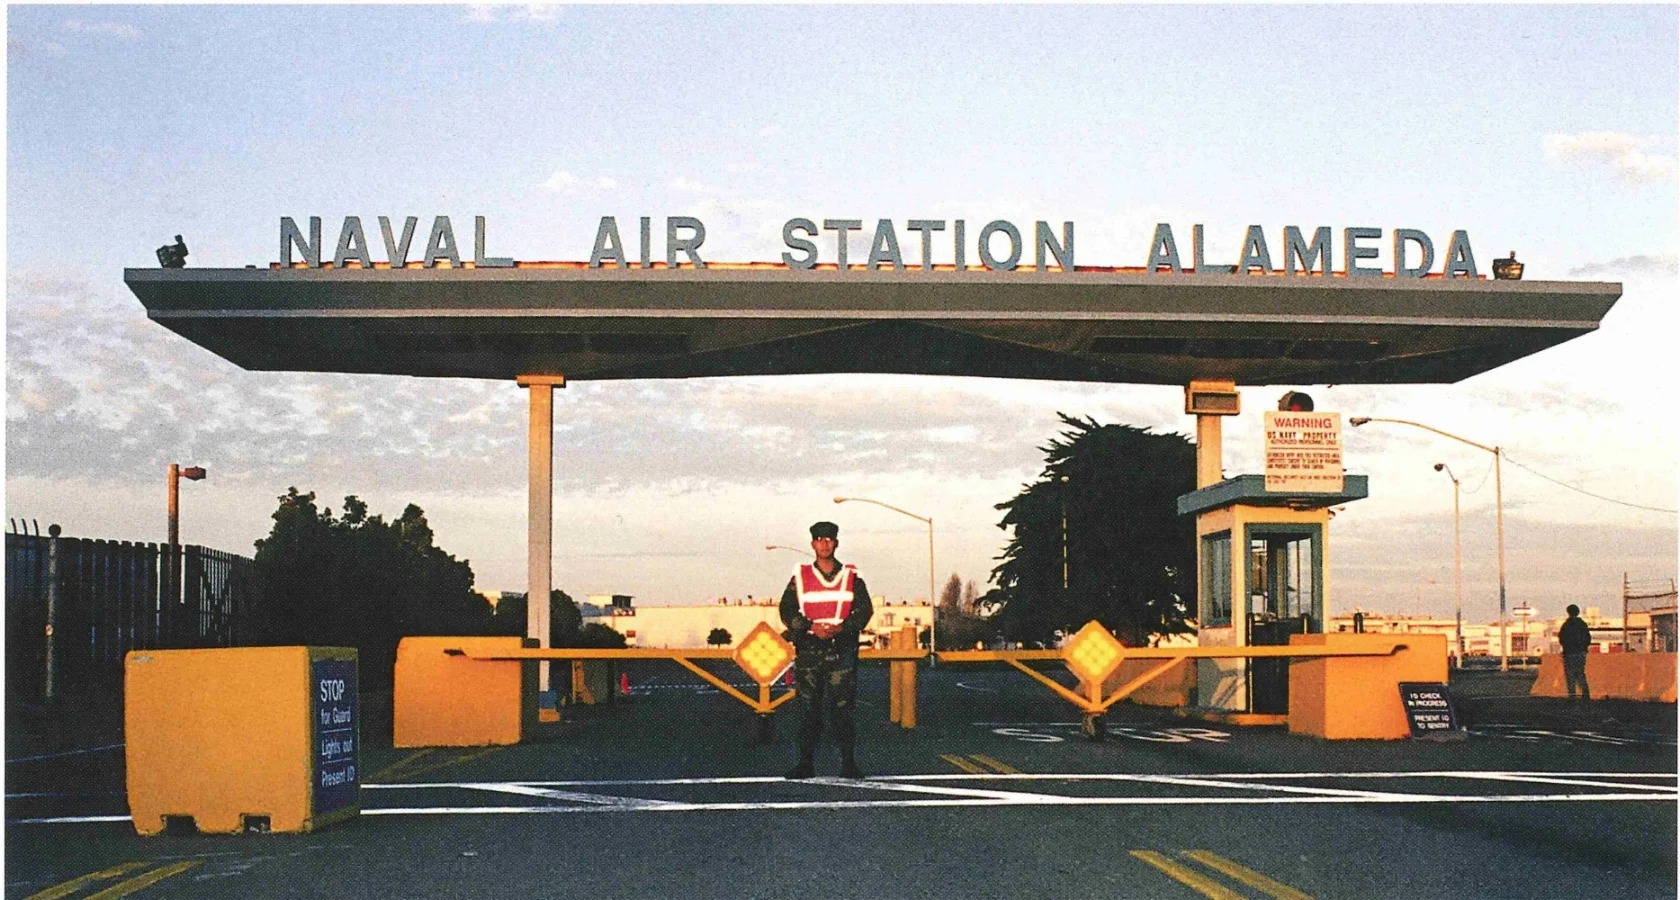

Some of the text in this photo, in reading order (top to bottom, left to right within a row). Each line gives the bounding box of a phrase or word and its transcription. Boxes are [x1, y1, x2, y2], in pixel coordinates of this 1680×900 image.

[279, 215, 1479, 279] NAVAL AIR STATION ALAMEDA
[1274, 418, 1332, 428] WARNING
[1267, 431, 1337, 440] US NAVY PROPERTY
[320, 678, 345, 702] STOP
[320, 705, 351, 725] for Guard
[992, 728, 1232, 743] SOP
[321, 738, 353, 759] Lights out
[321, 765, 355, 787] Present ID
